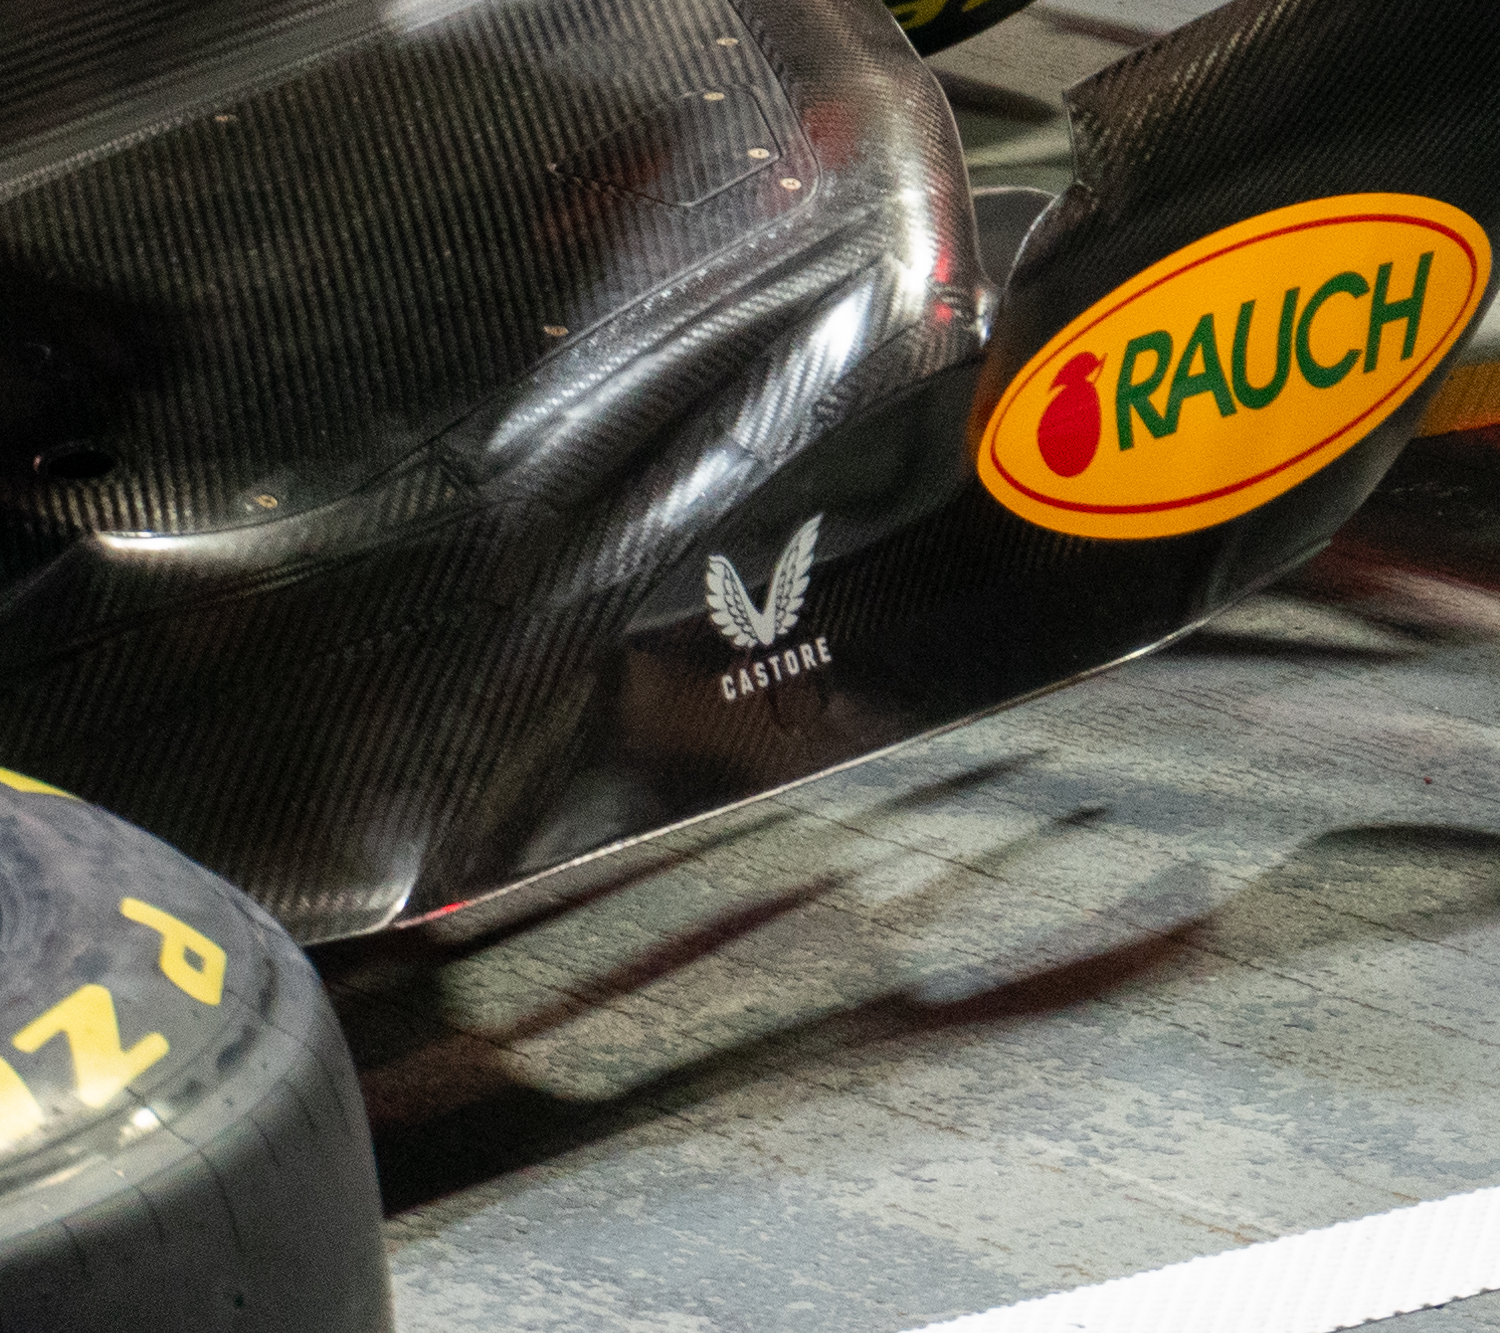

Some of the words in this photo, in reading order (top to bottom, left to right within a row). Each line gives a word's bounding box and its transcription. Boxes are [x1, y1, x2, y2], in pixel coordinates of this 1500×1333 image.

[1114, 249, 1436, 452] RAUCH
[721, 634, 833, 703] CASTORE
[118, 897, 228, 1006] P
